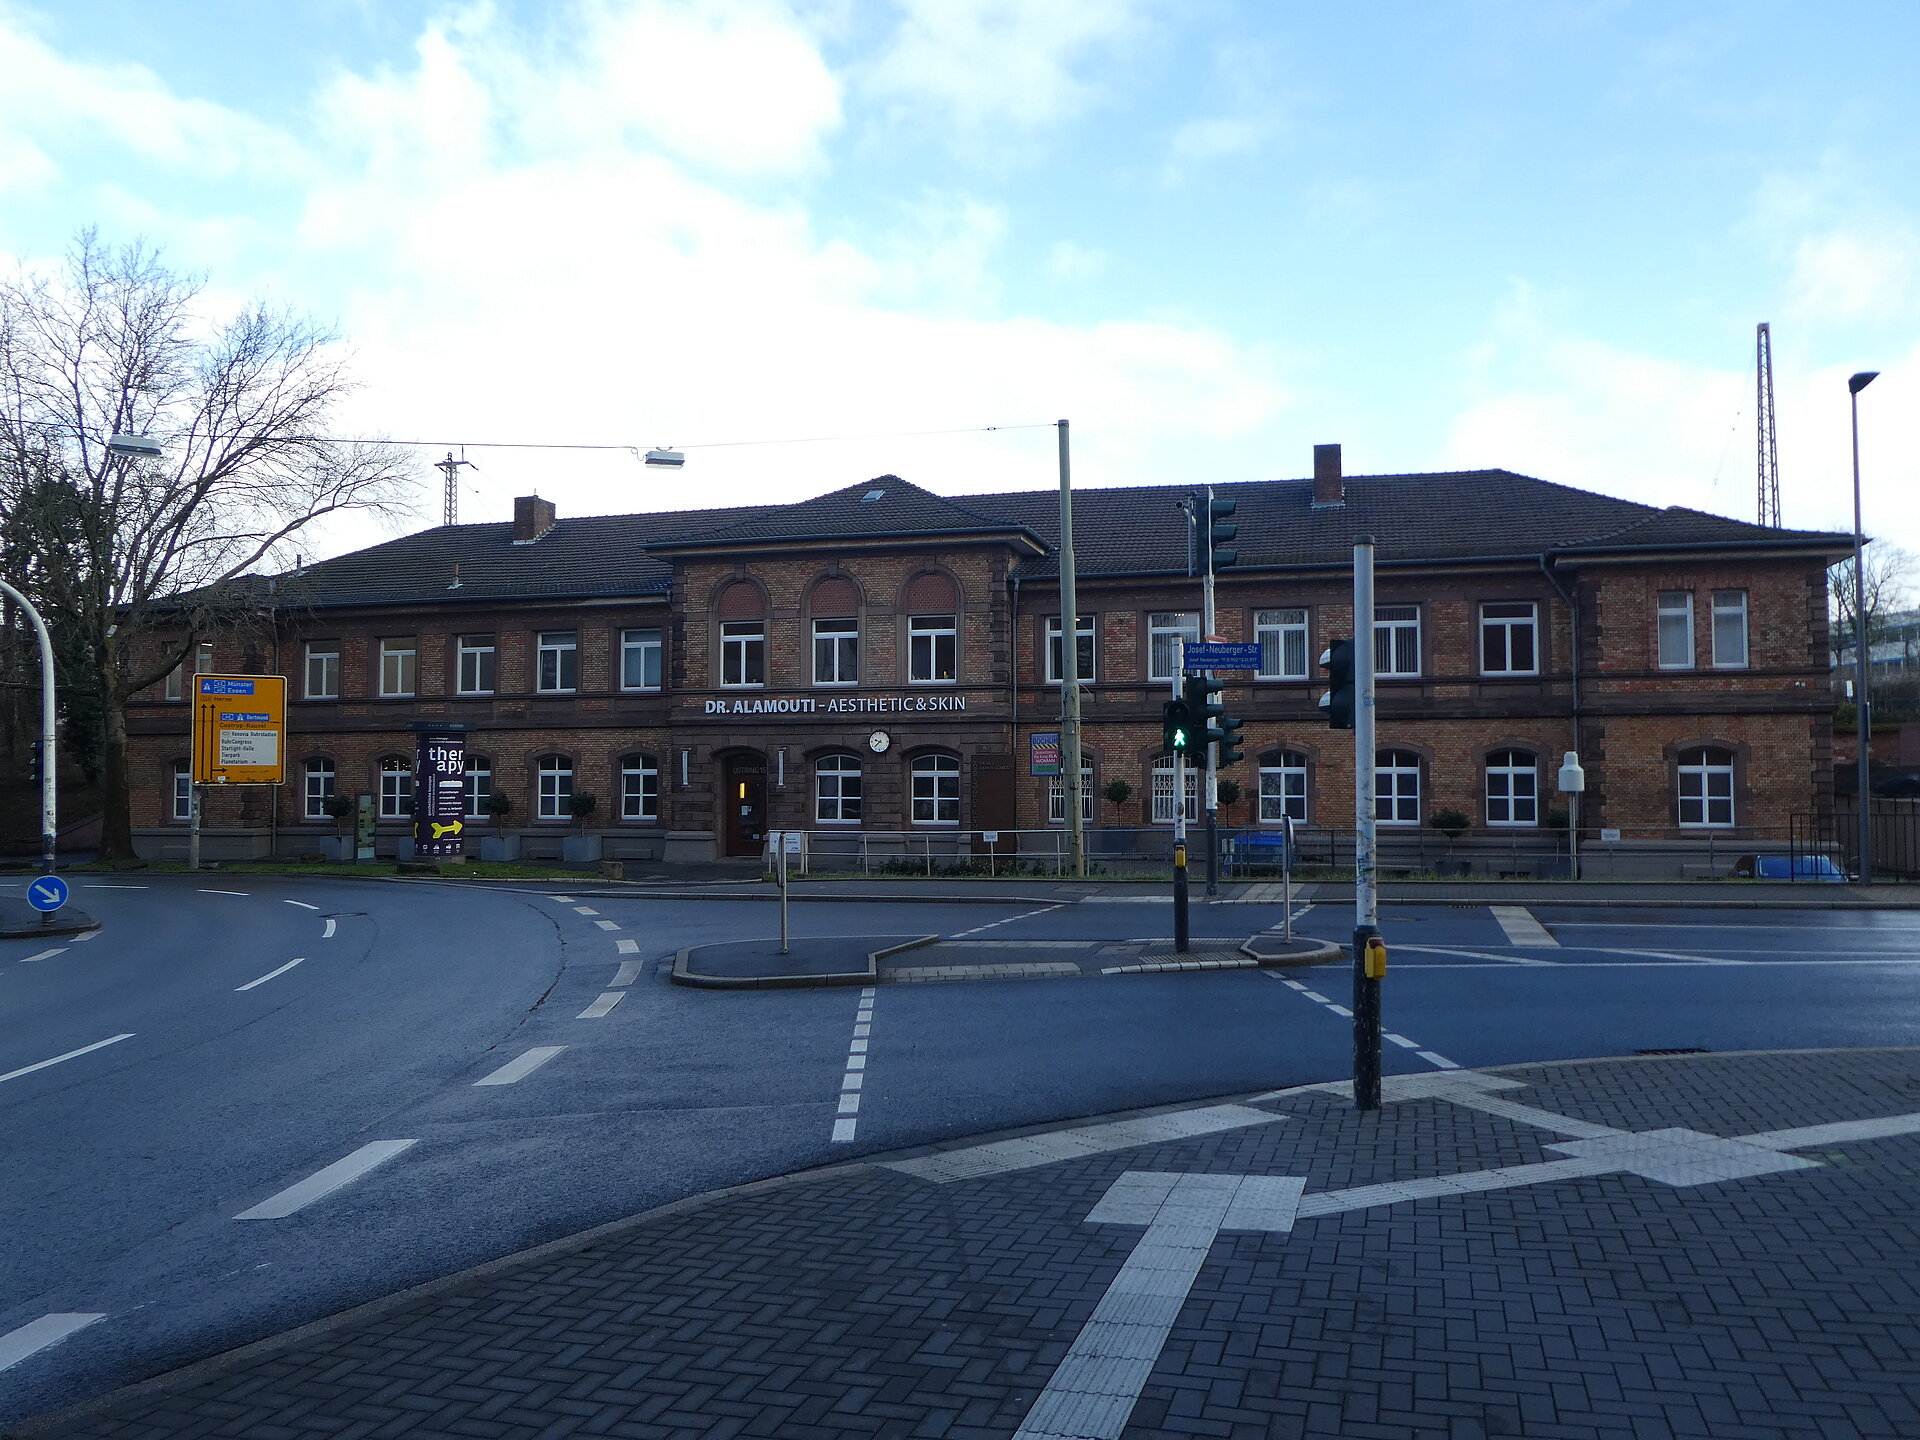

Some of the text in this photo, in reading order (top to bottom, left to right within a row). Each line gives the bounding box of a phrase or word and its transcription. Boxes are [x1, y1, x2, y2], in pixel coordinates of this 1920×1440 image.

[705, 700, 730, 713] DR.
[733, 699, 815, 713] ALAMOUTI
[428, 746, 464, 761] ther
[436, 760, 465, 775] apy
